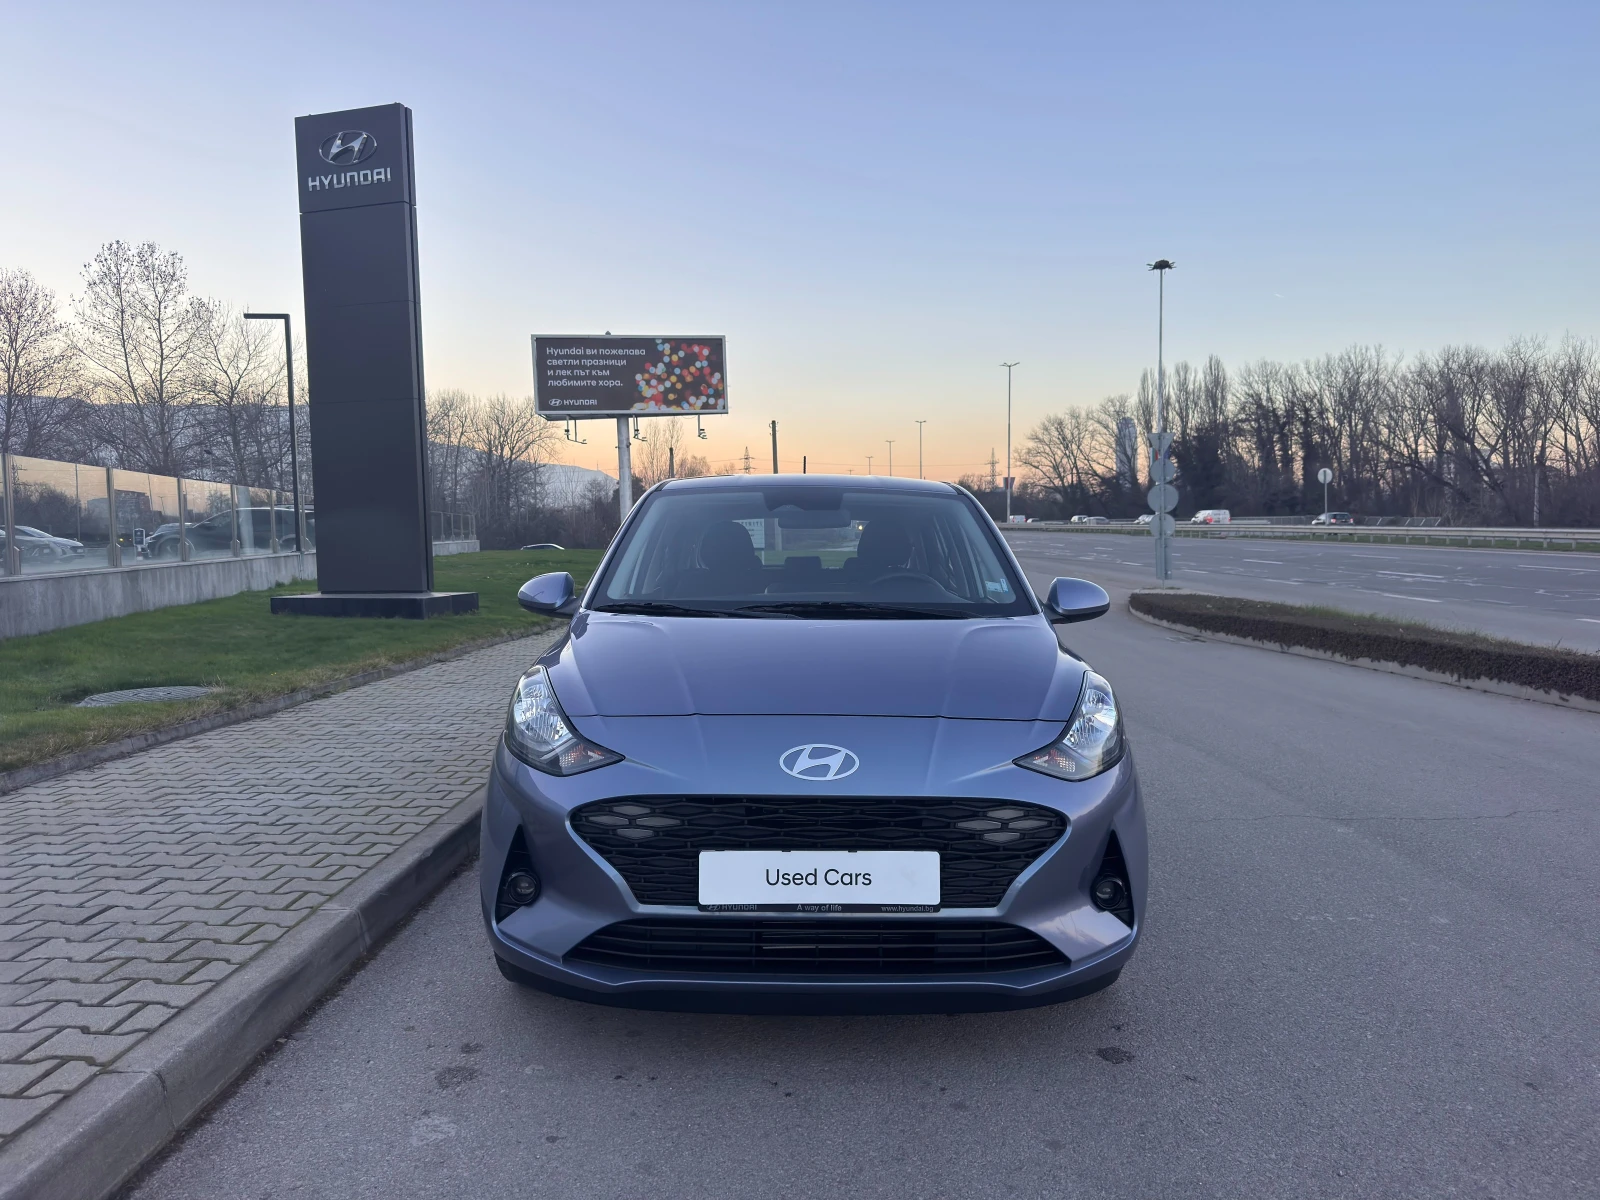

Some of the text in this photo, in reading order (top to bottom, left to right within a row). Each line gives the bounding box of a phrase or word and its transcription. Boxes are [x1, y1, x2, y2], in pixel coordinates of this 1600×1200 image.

[308, 167, 391, 191] HYUNDAI
[546, 346, 646, 356] Hyundai ви пожелава
[581, 359, 627, 367] празници
[548, 378, 623, 388] любимите хора.
[765, 868, 872, 886] Used Cars
